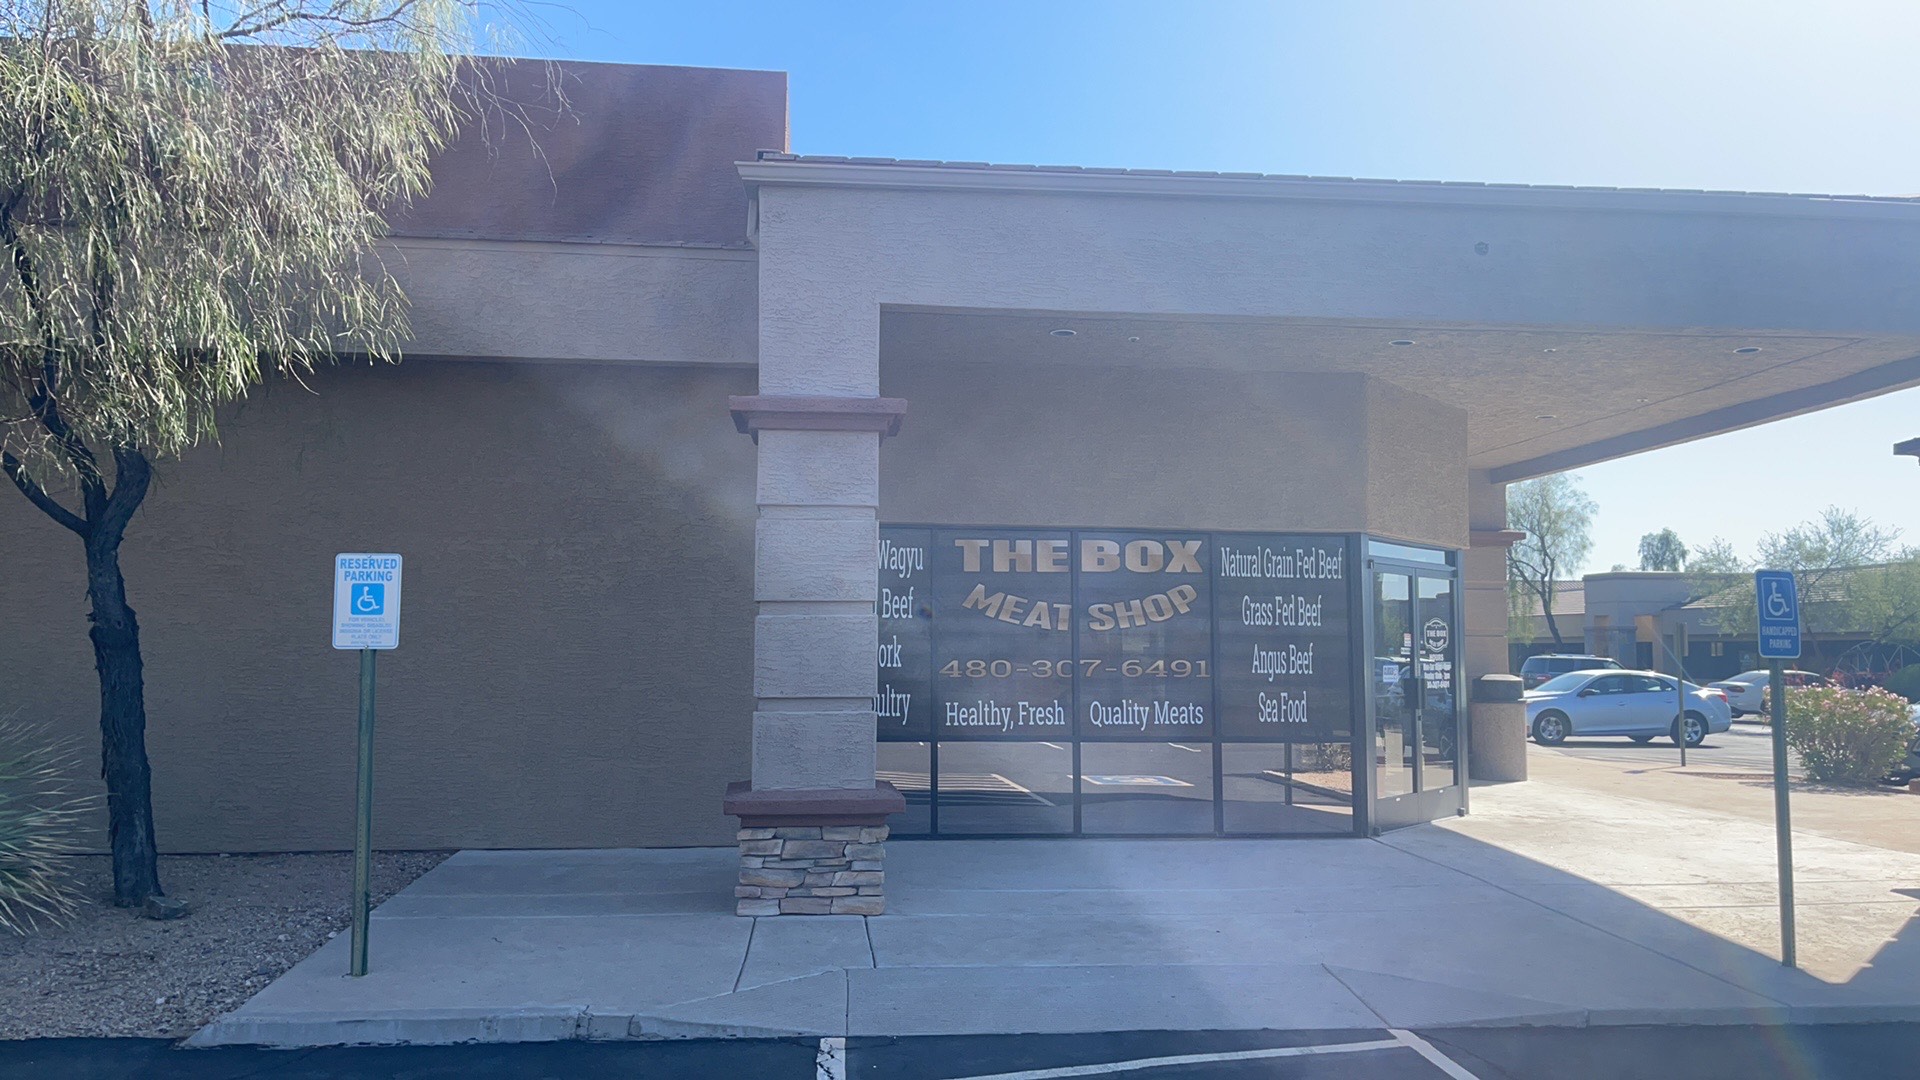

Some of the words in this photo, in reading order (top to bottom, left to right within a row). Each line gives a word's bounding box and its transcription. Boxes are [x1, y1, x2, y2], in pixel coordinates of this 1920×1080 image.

[340, 558, 397, 570] RESERVED
[878, 540, 923, 578] Wagyu
[955, 540, 1069, 573] THE
[1081, 540, 1203, 573] BOX
[1221, 546, 1261, 578] Natural
[1263, 546, 1294, 579] Grain
[1296, 547, 1316, 579] Fed
[1318, 547, 1343, 579] Beef
[344, 570, 393, 582] PARKING
[882, 586, 914, 619] Beef
[962, 583, 1072, 631] MEAT
[1088, 584, 1198, 631] SHOP
[1242, 595, 1273, 626] Grass
[1275, 594, 1296, 626] Fed
[1298, 594, 1322, 627] Beef
[1761, 626, 1797, 636] HANDICAPPED
[1769, 639, 1792, 649] PARKING
[878, 635, 902, 668] ork
[1252, 643, 1287, 682] Angus
[1289, 642, 1313, 674] Beef
[938, 659, 1211, 679] 480-307-6491
[873, 684, 911, 726] ultry
[945, 701, 1014, 732] Healthy,
[1018, 700, 1066, 726] Fresh
[1090, 700, 1150, 732] Quality
[1154, 701, 1204, 726] Meats
[1258, 691, 1278, 723] Sea
[1280, 690, 1308, 723] Food
